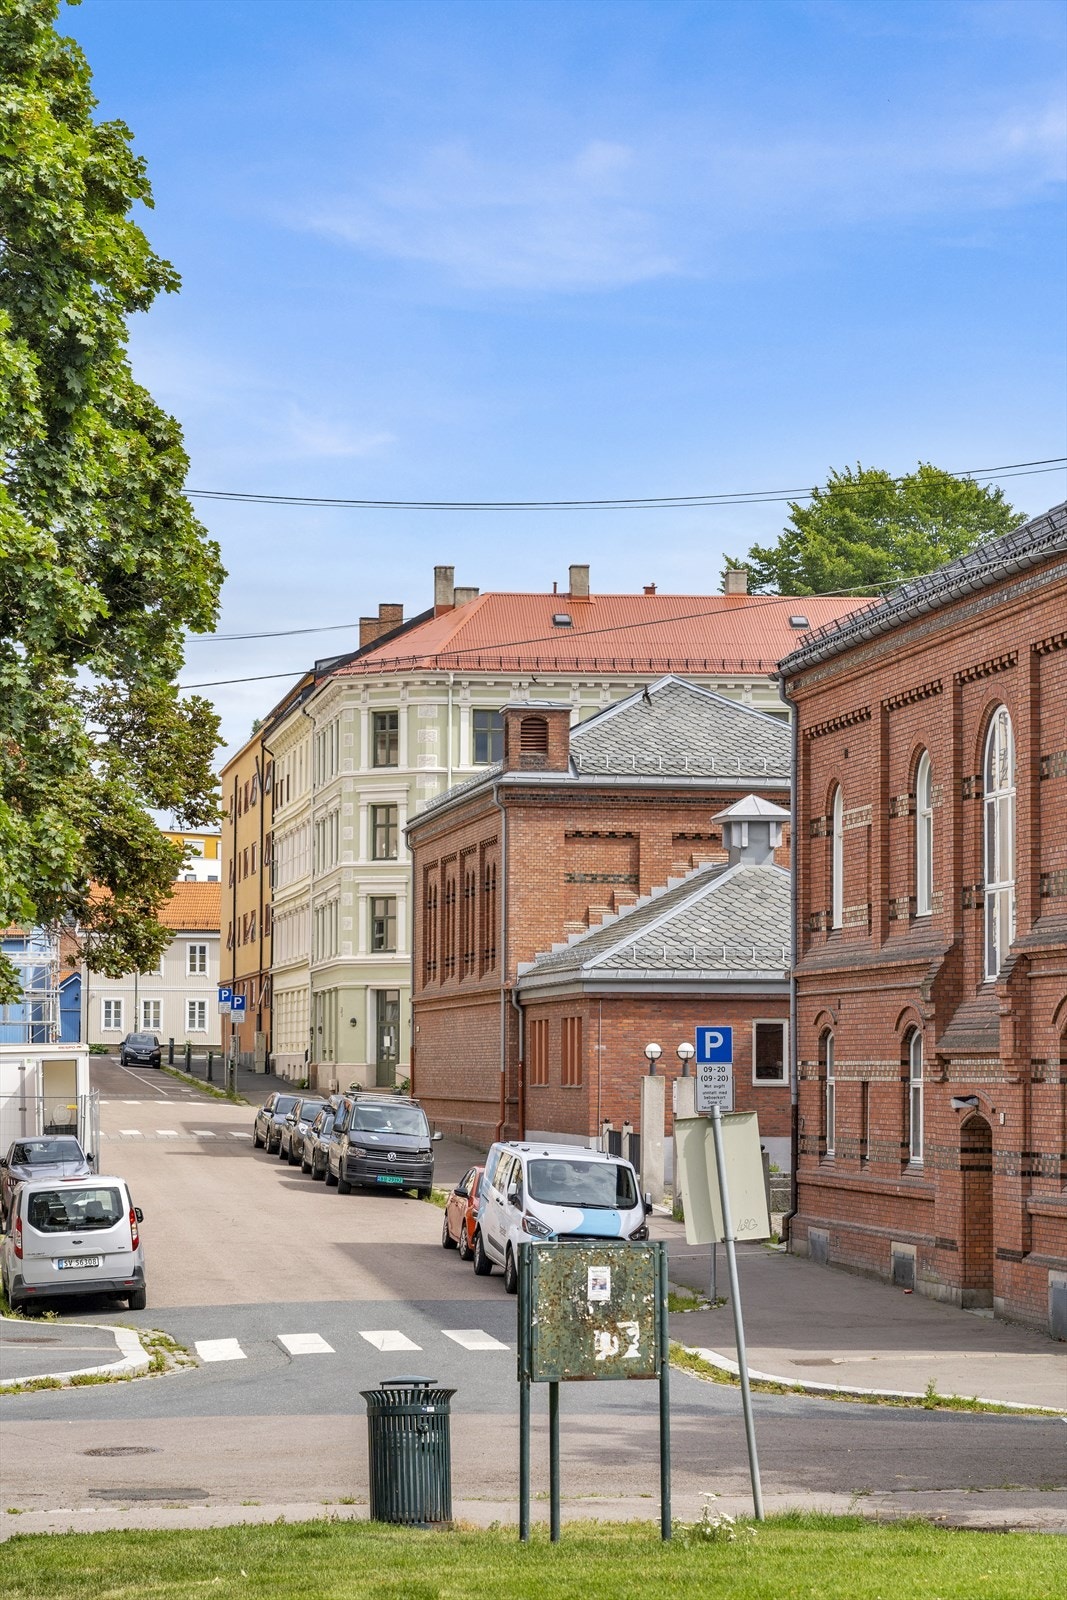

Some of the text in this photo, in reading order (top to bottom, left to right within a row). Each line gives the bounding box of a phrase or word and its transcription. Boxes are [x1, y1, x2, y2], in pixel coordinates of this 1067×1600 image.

[221, 990, 229, 1001] P
[233, 997, 242, 1008] P
[704, 1031, 724, 1059] P
[64, 1259, 73, 1267] SV
